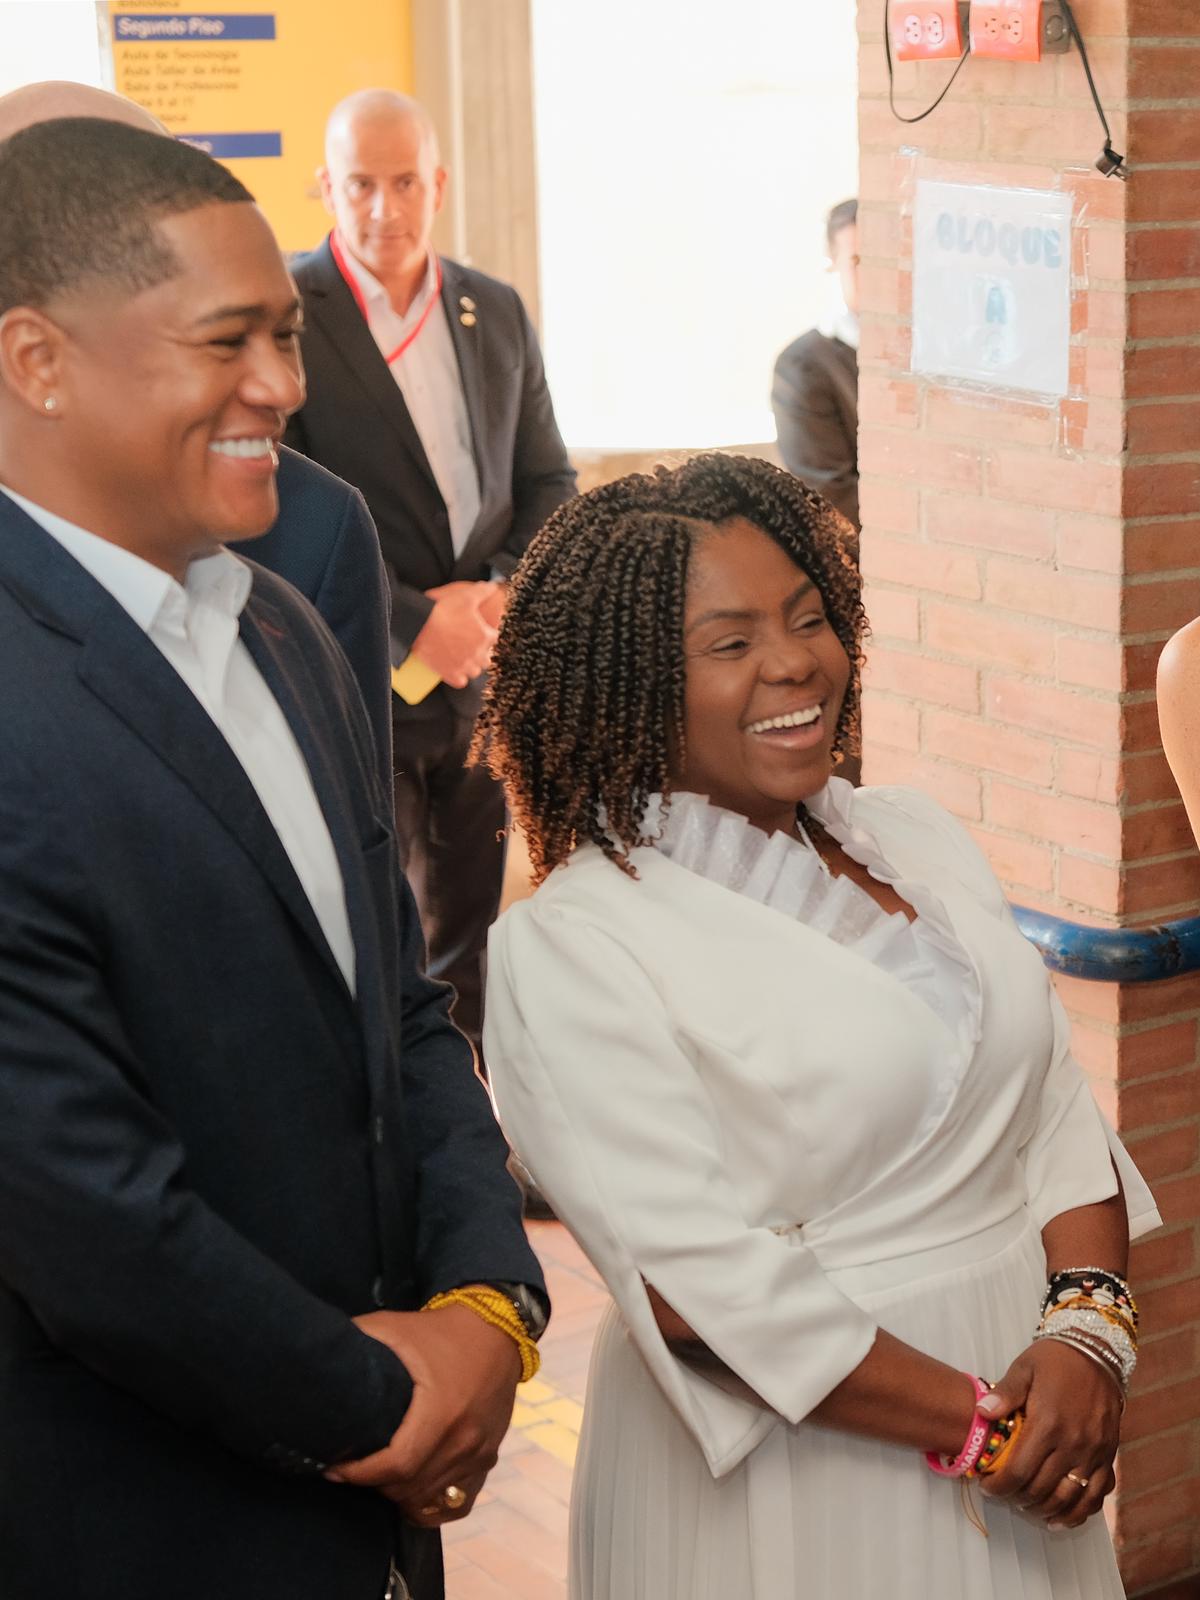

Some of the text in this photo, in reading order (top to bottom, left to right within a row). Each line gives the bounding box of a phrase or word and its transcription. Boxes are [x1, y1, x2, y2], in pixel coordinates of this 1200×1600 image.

[118, 17, 225, 38] Segundo Piso
[935, 211, 1062, 269] BLOQUE
